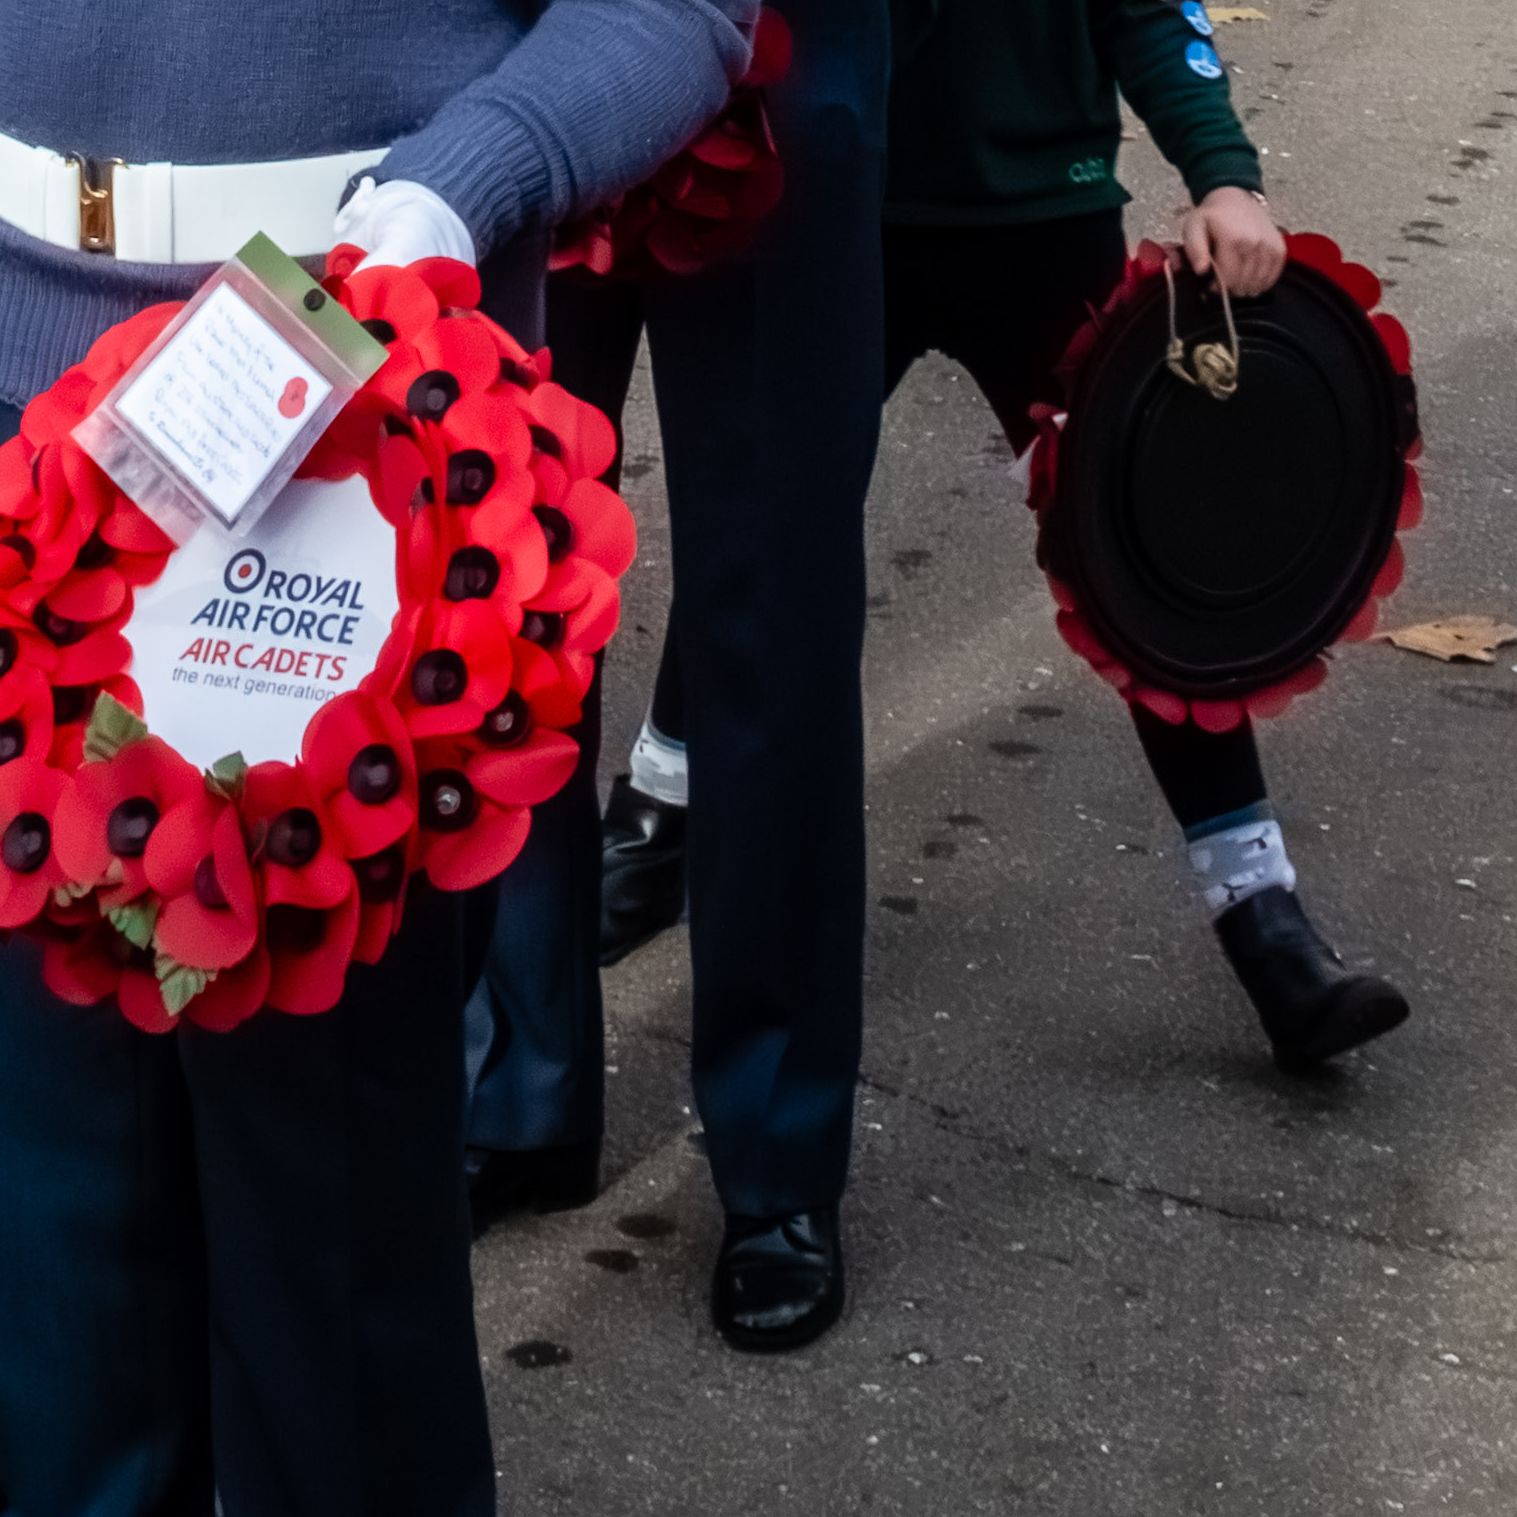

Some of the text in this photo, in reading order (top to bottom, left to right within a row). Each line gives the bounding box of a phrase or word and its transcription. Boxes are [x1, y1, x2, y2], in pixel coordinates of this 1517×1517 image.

[264, 570, 364, 610] ROYAL
[190, 598, 361, 645] AIR FORCE
[179, 637, 348, 682] AIR CADETS
[172, 667, 338, 703] the next generation
